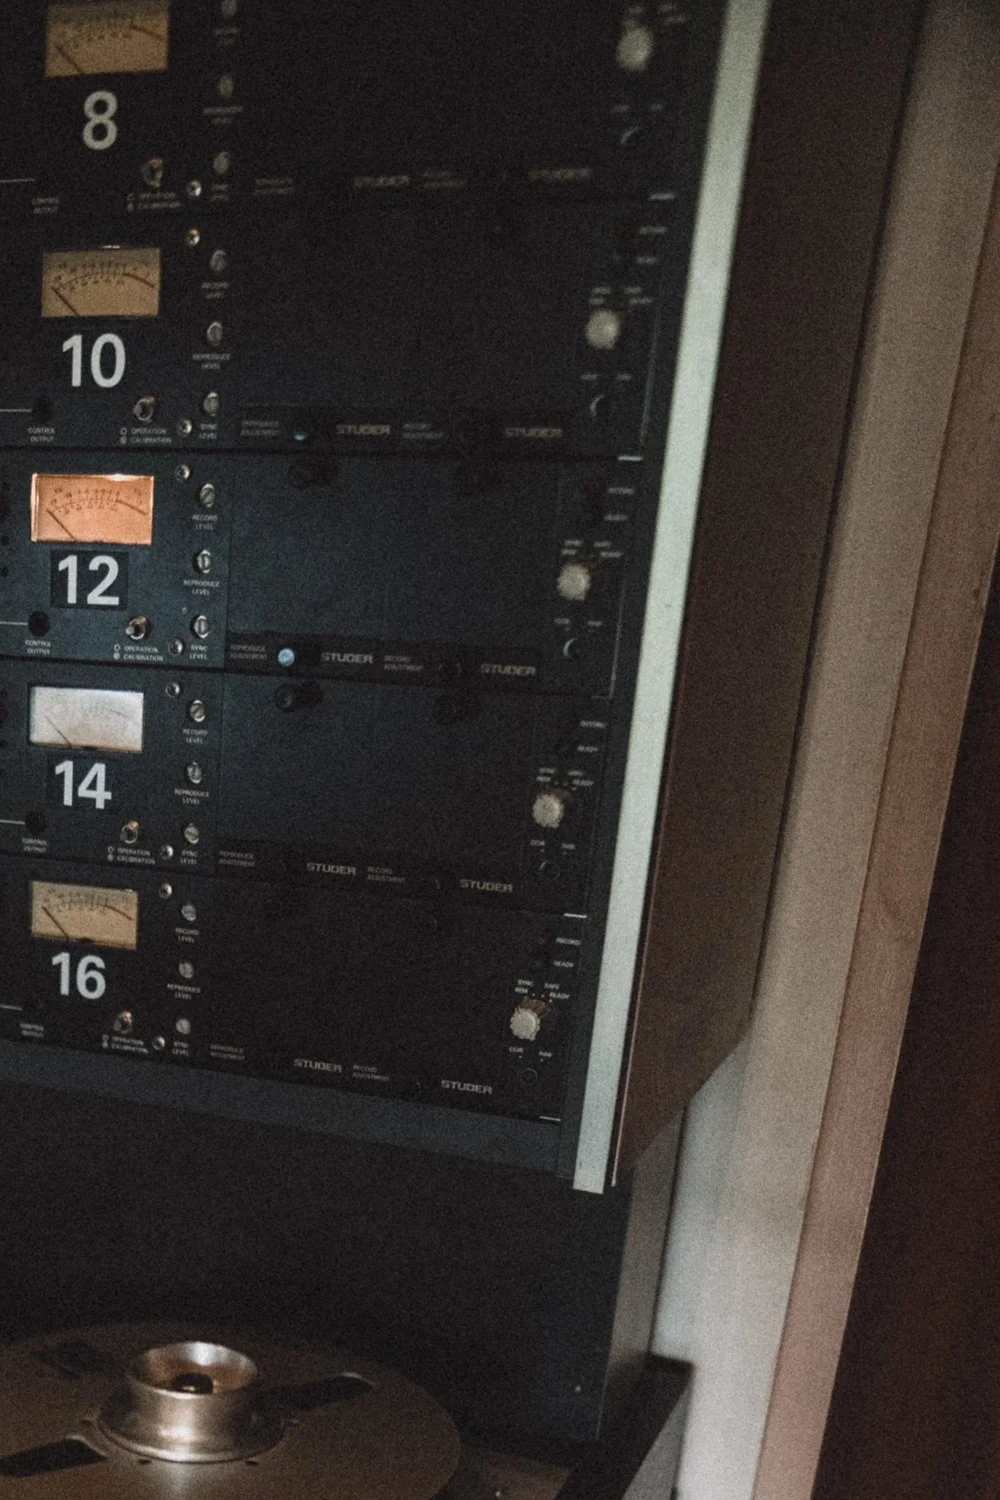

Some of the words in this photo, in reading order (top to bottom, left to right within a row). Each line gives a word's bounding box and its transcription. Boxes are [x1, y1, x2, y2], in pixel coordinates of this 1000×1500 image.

[82, 90, 118, 151] 8
[62, 332, 126, 388] 10
[336, 424, 391, 436] STUDER
[57, 554, 120, 606] 12
[321, 651, 373, 665] STUDER
[480, 663, 537, 677] STUDER
[54, 760, 112, 810] 14
[306, 862, 356, 876] STUDER
[459, 878, 513, 893] STUDER
[51, 951, 107, 1000] 16
[294, 1058, 342, 1073] STUDER
[441, 1079, 493, 1094] STUDER
